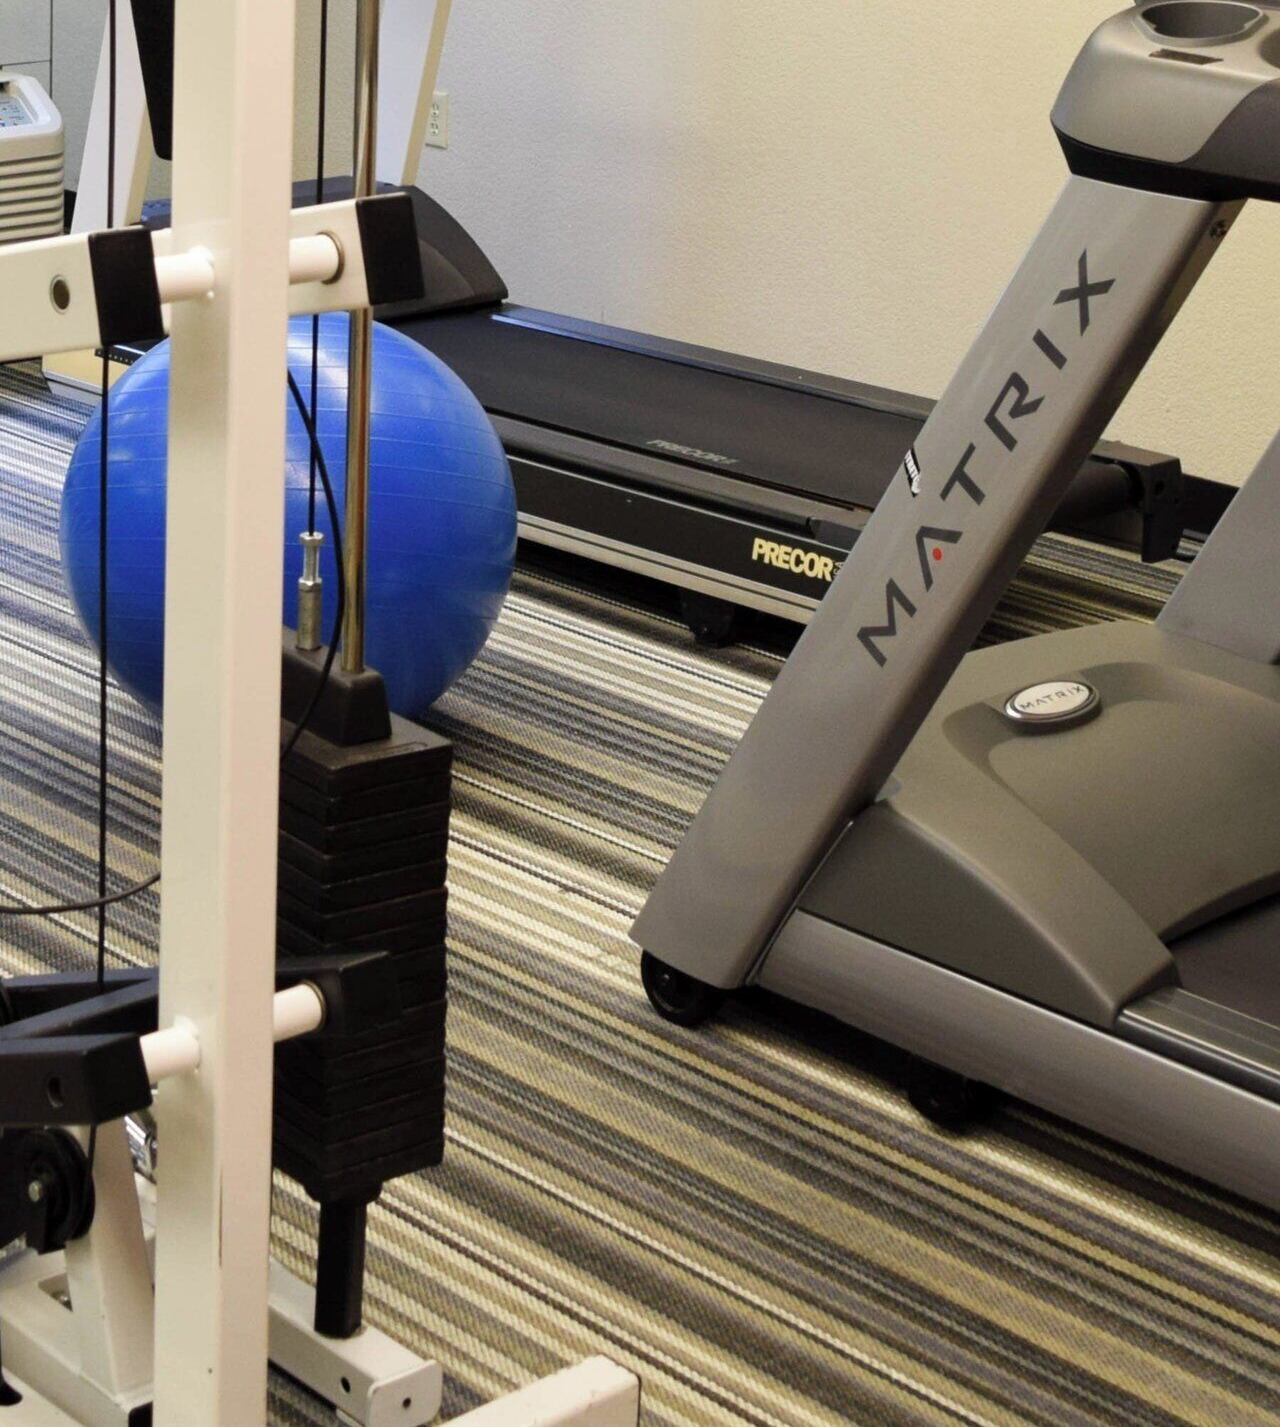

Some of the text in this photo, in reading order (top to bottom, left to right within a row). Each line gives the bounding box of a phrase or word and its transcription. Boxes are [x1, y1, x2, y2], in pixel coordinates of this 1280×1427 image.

[857, 248, 1116, 668] MATRIX
[752, 537, 836, 582] PRECOR
[1019, 685, 1084, 710] MATRIX
